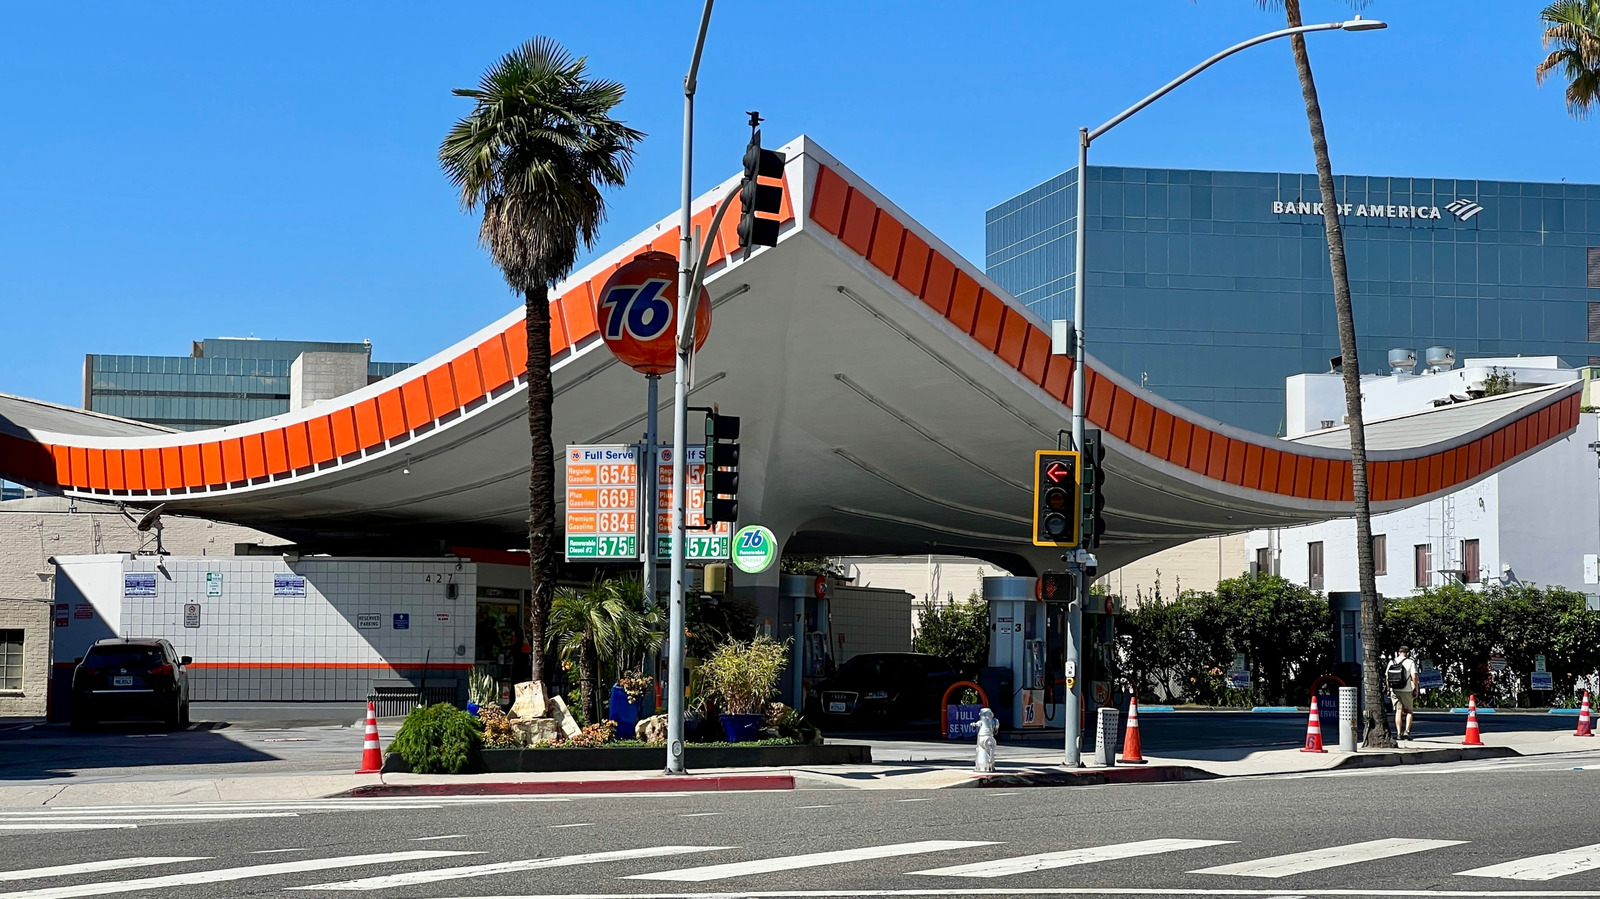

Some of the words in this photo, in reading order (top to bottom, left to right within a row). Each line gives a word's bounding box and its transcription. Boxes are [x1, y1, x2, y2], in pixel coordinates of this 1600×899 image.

[1273, 200, 1324, 214] BANK
[1355, 203, 1443, 219] AMERICA
[602, 277, 673, 341] 76
[584, 450, 603, 460] Full
[605, 450, 634, 460] Serve
[568, 468, 591, 476] Regular
[600, 465, 630, 484] 654
[569, 491, 582, 499] Plus
[600, 489, 629, 508] 669
[569, 499, 595, 507] Gasoline
[568, 515, 595, 523] Premium
[600, 513, 629, 532] 684
[742, 529, 763, 547] 76
[598, 537, 628, 556] 575
[690, 537, 720, 557] 575
[795, 613, 802, 622] 7
[1015, 623, 1022, 632] 3
[1321, 700, 1337, 708] FULL
[1024, 703, 1036, 724] 76
[1320, 710, 1339, 718] ERVIC
[949, 724, 978, 733] SERVIC
[1307, 735, 1316, 749] 6
